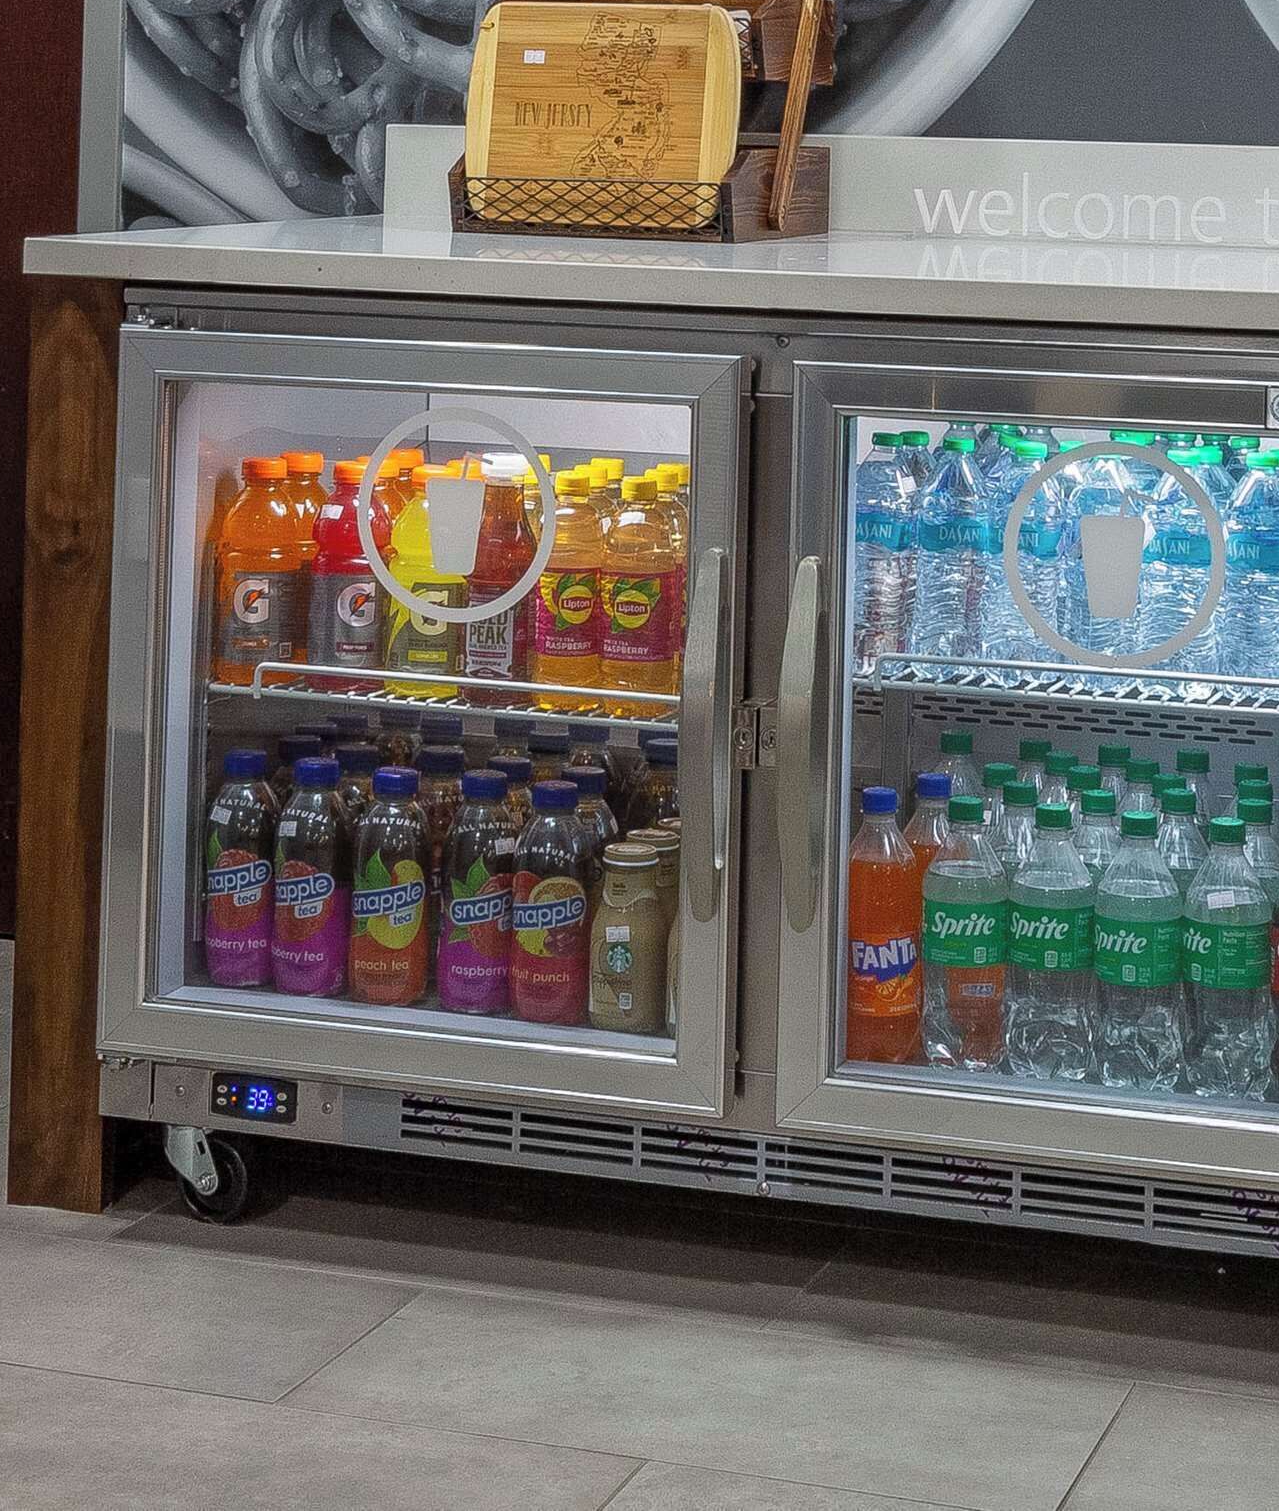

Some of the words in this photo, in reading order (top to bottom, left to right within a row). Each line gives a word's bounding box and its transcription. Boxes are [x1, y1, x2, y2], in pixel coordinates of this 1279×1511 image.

[913, 172, 1226, 244] welcome
[856, 519, 892, 539] ASANI
[1227, 542, 1260, 560] ASANI
[233, 579, 270, 624] G
[337, 582, 376, 627] G
[563, 598, 590, 609] Lipton
[618, 603, 645, 613] Lipton
[469, 625, 506, 645] PEAK
[545, 640, 591, 650] RASPBERRY
[603, 644, 648, 655] RASPBERRY
[221, 798, 265, 811] NATURAL
[372, 816, 420, 829] NATURAL
[531, 846, 576, 863] NATURAL
[208, 864, 267, 893] napple
[236, 891, 258, 905] tea
[276, 878, 329, 905] apple
[354, 885, 421, 915] snapple
[297, 904, 318, 916] tea
[453, 896, 512, 923] snapp
[393, 912, 412, 925] tea
[931, 912, 996, 939] Sprite
[1010, 912, 1069, 939] Sprite
[247, 938, 267, 949] tea
[304, 950, 324, 962] tea
[851, 937, 918, 970] FANTA
[354, 959, 387, 971] peach
[391, 959, 409, 971] tea
[451, 964, 507, 978] raspberry
[533, 971, 570, 983] punch
[246, 1088, 269, 1110] 39
